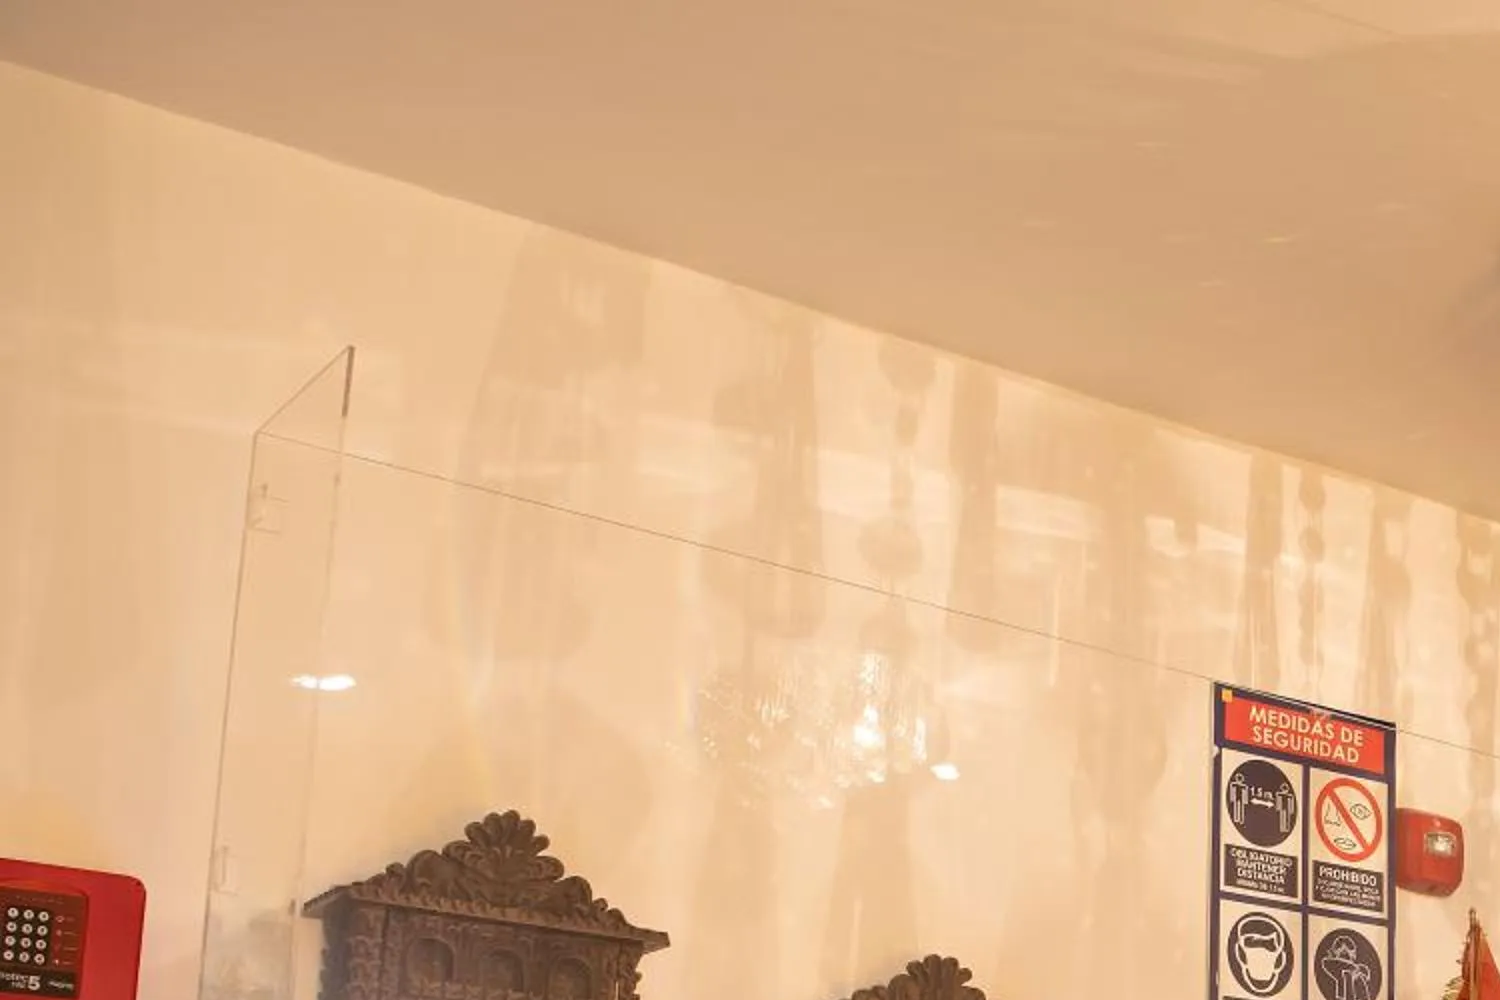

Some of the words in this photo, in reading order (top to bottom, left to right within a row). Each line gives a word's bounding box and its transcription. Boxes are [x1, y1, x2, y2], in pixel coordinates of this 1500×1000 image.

[1250, 706, 1335, 739] MEDIDAS
[1340, 727, 1364, 747] DE
[1252, 725, 1360, 764] SEGURIDAD
[1237, 866, 1286, 884] DISTANCIA
[1319, 865, 1377, 887] PROHIBIDO
[28, 975, 41, 991] 5
